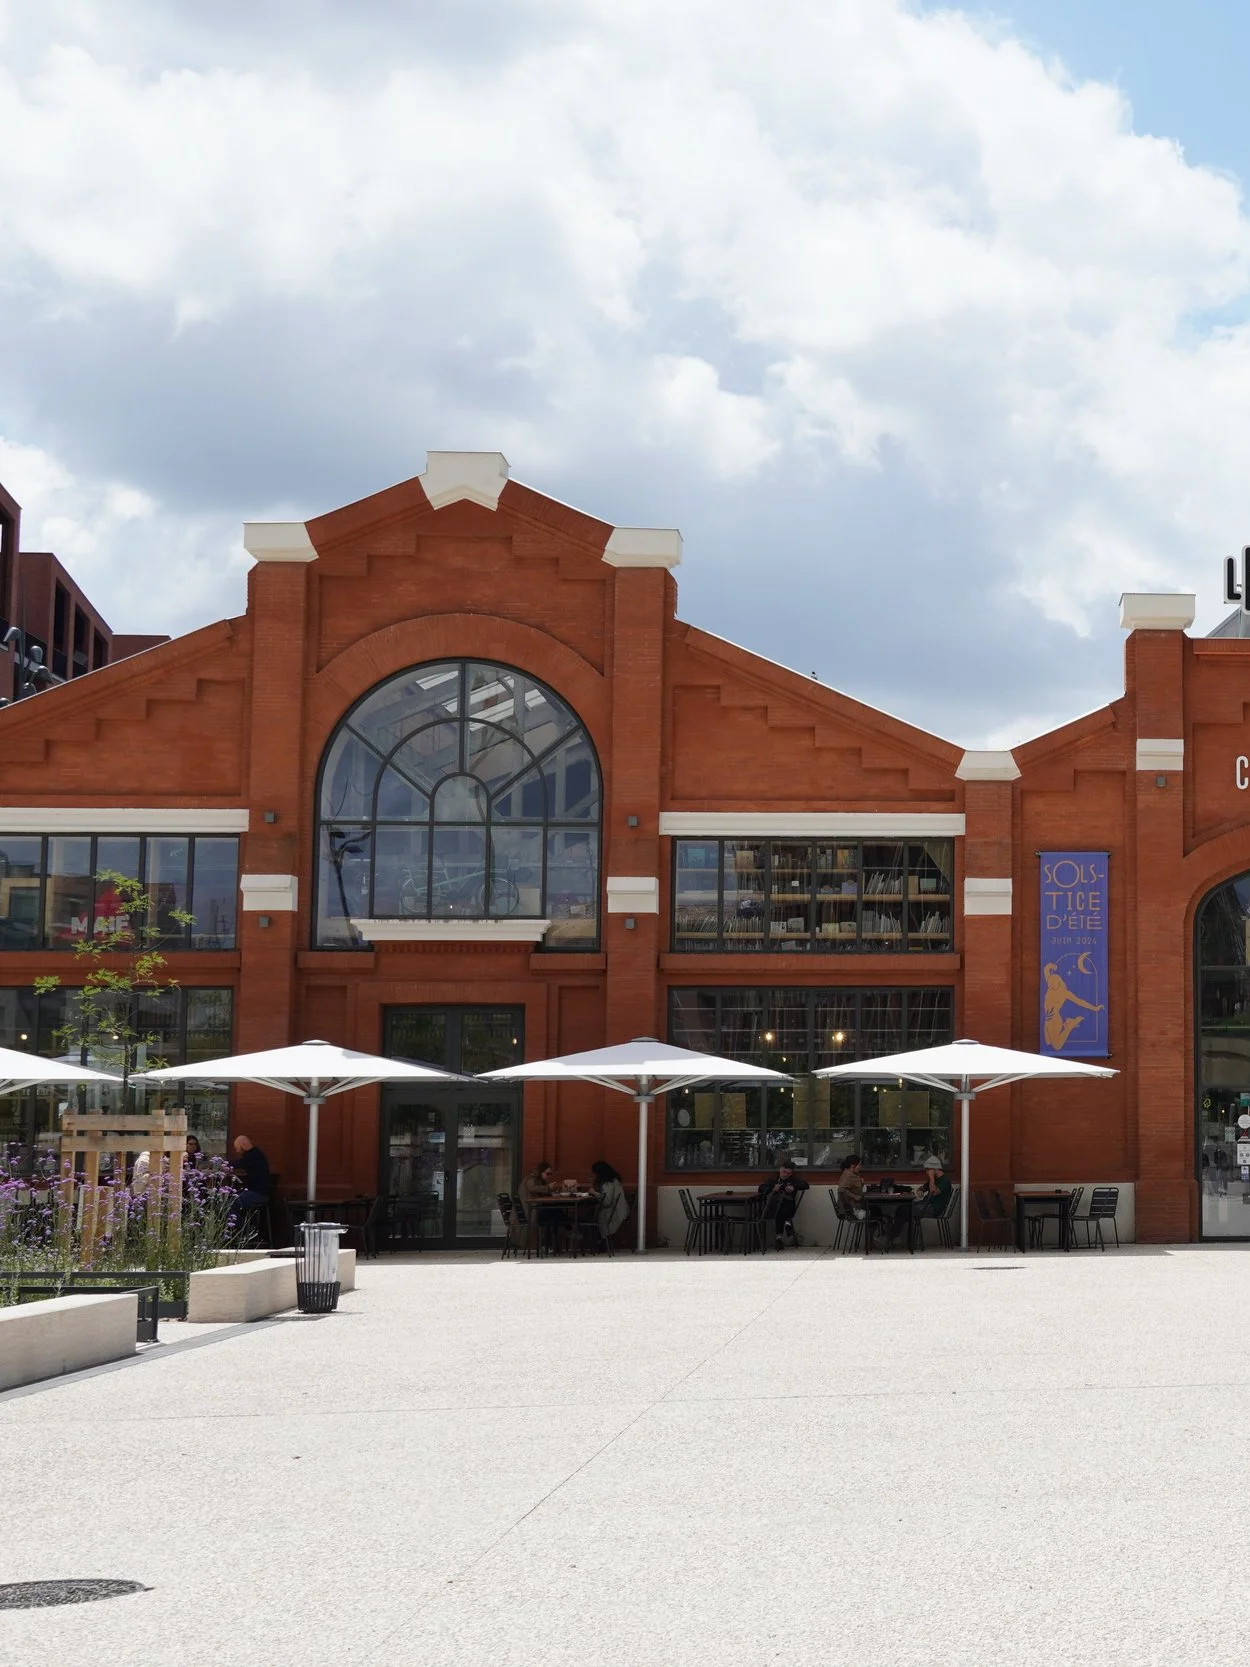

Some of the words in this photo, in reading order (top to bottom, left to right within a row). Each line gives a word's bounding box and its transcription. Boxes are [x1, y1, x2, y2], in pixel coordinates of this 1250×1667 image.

[1044, 860, 1105, 888] SOLS-
[1044, 891, 1101, 911] TICE
[1051, 936, 1072, 945] JUIN
[1076, 936, 1097, 945] 2024
